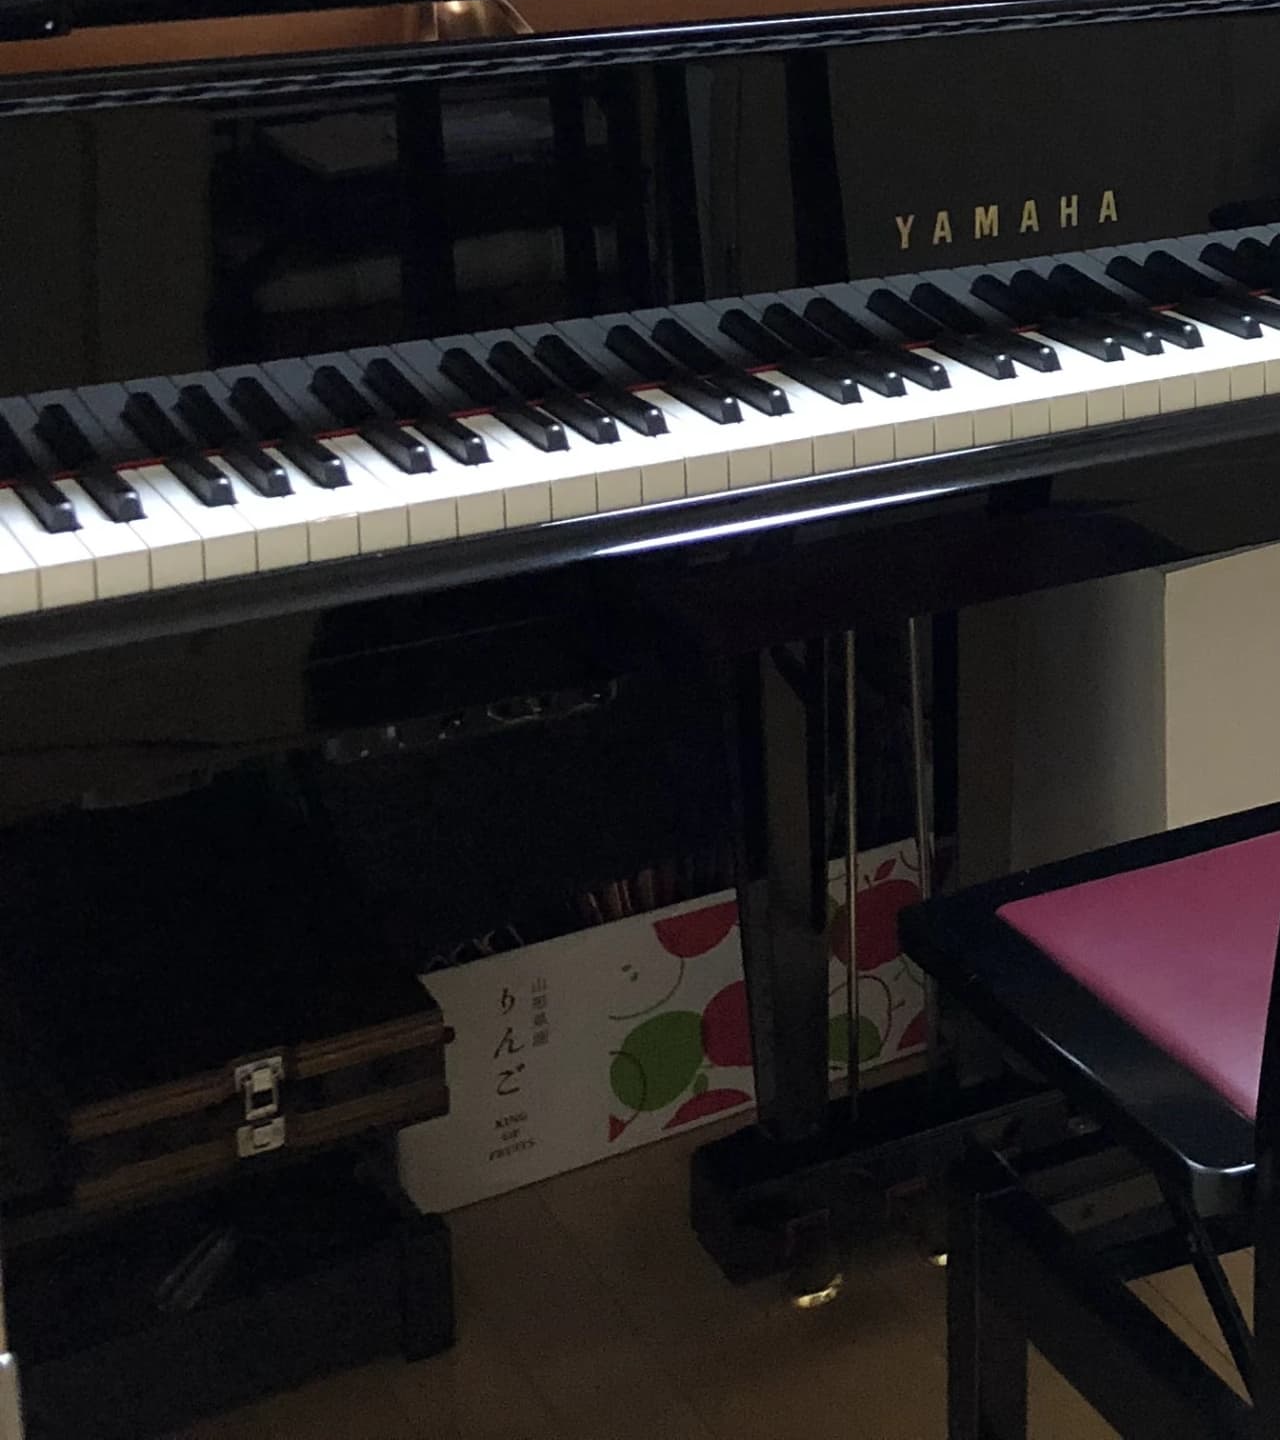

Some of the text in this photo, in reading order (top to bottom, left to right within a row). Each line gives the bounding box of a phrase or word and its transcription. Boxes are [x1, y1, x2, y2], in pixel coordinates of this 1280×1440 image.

[895, 190, 1118, 250] YAMAHA
[493, 986, 526, 1097] りんご
[494, 1111, 528, 1129] KING
[489, 1137, 536, 1161] FRUITS
